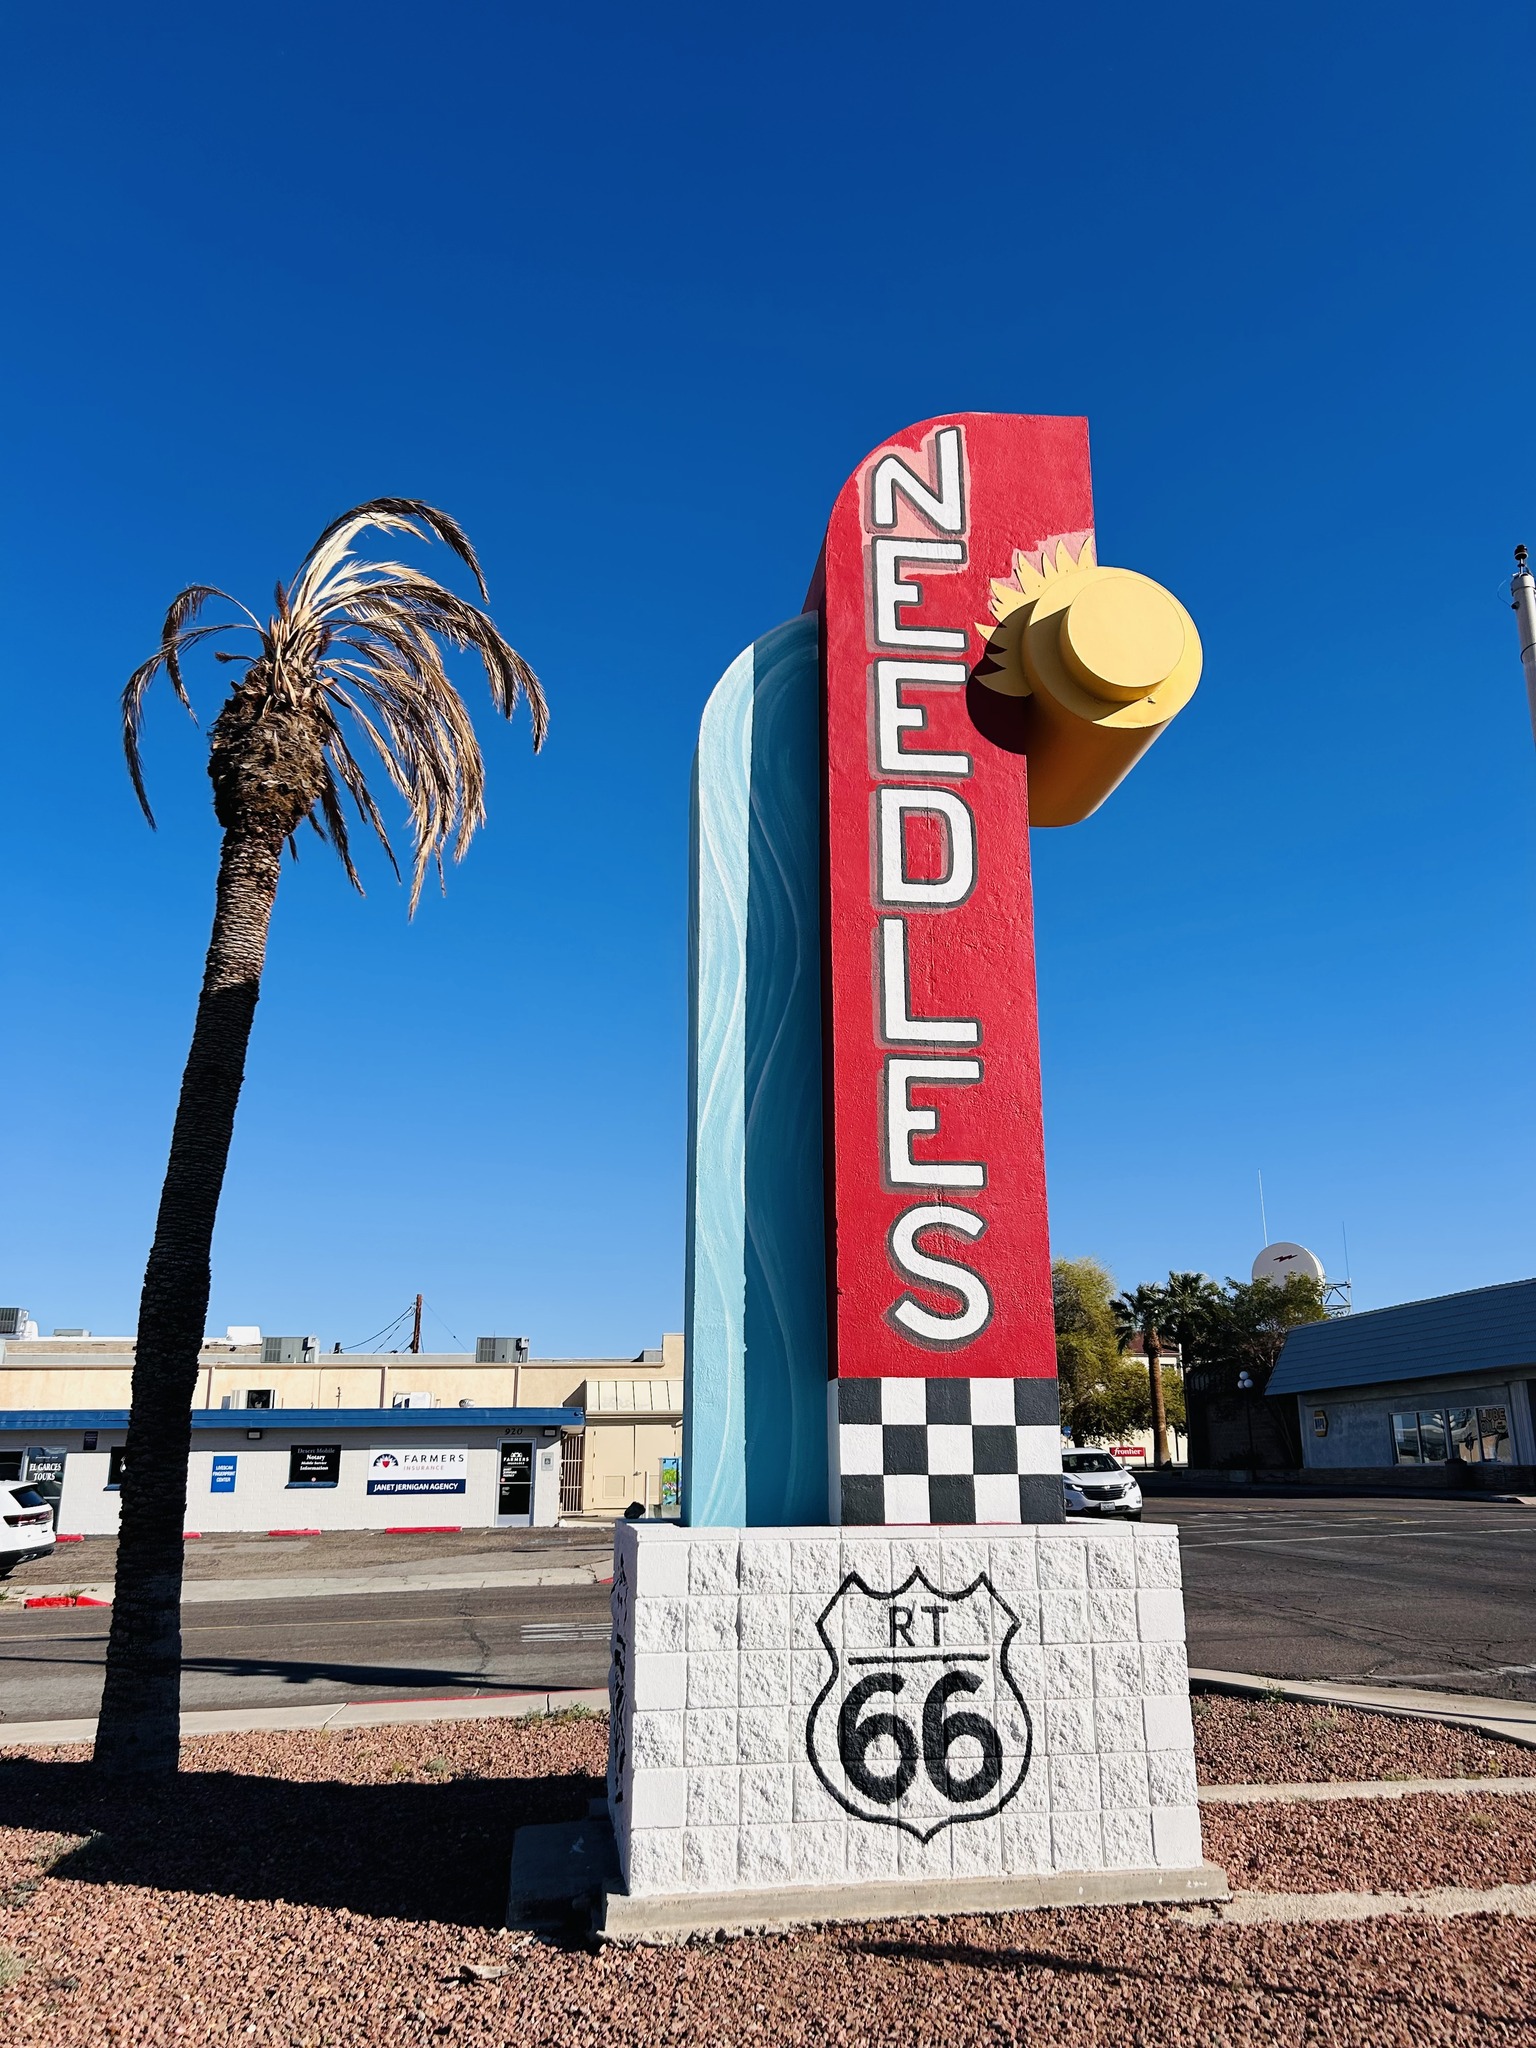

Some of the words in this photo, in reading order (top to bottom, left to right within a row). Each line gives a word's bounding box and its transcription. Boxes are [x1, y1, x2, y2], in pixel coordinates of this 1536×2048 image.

[869, 426, 993, 1346] NEEDLES
[1478, 1407, 1506, 1421] LUBE
[504, 1427, 523, 1436] 920
[1479, 1420, 1496, 1433] OIL
[1113, 1447, 1142, 1456] frontier
[404, 1454, 465, 1463] FARMERS
[29, 1463, 37, 1472] EL
[37, 1463, 62, 1472] GARCES
[33, 1472, 56, 1482] TOURS
[373, 1483, 395, 1492] JANET
[395, 1483, 430, 1492] JERNIGAN
[430, 1483, 459, 1491] AGENCY
[888, 1605, 949, 1648] RT
[836, 1669, 1004, 1805] 66
